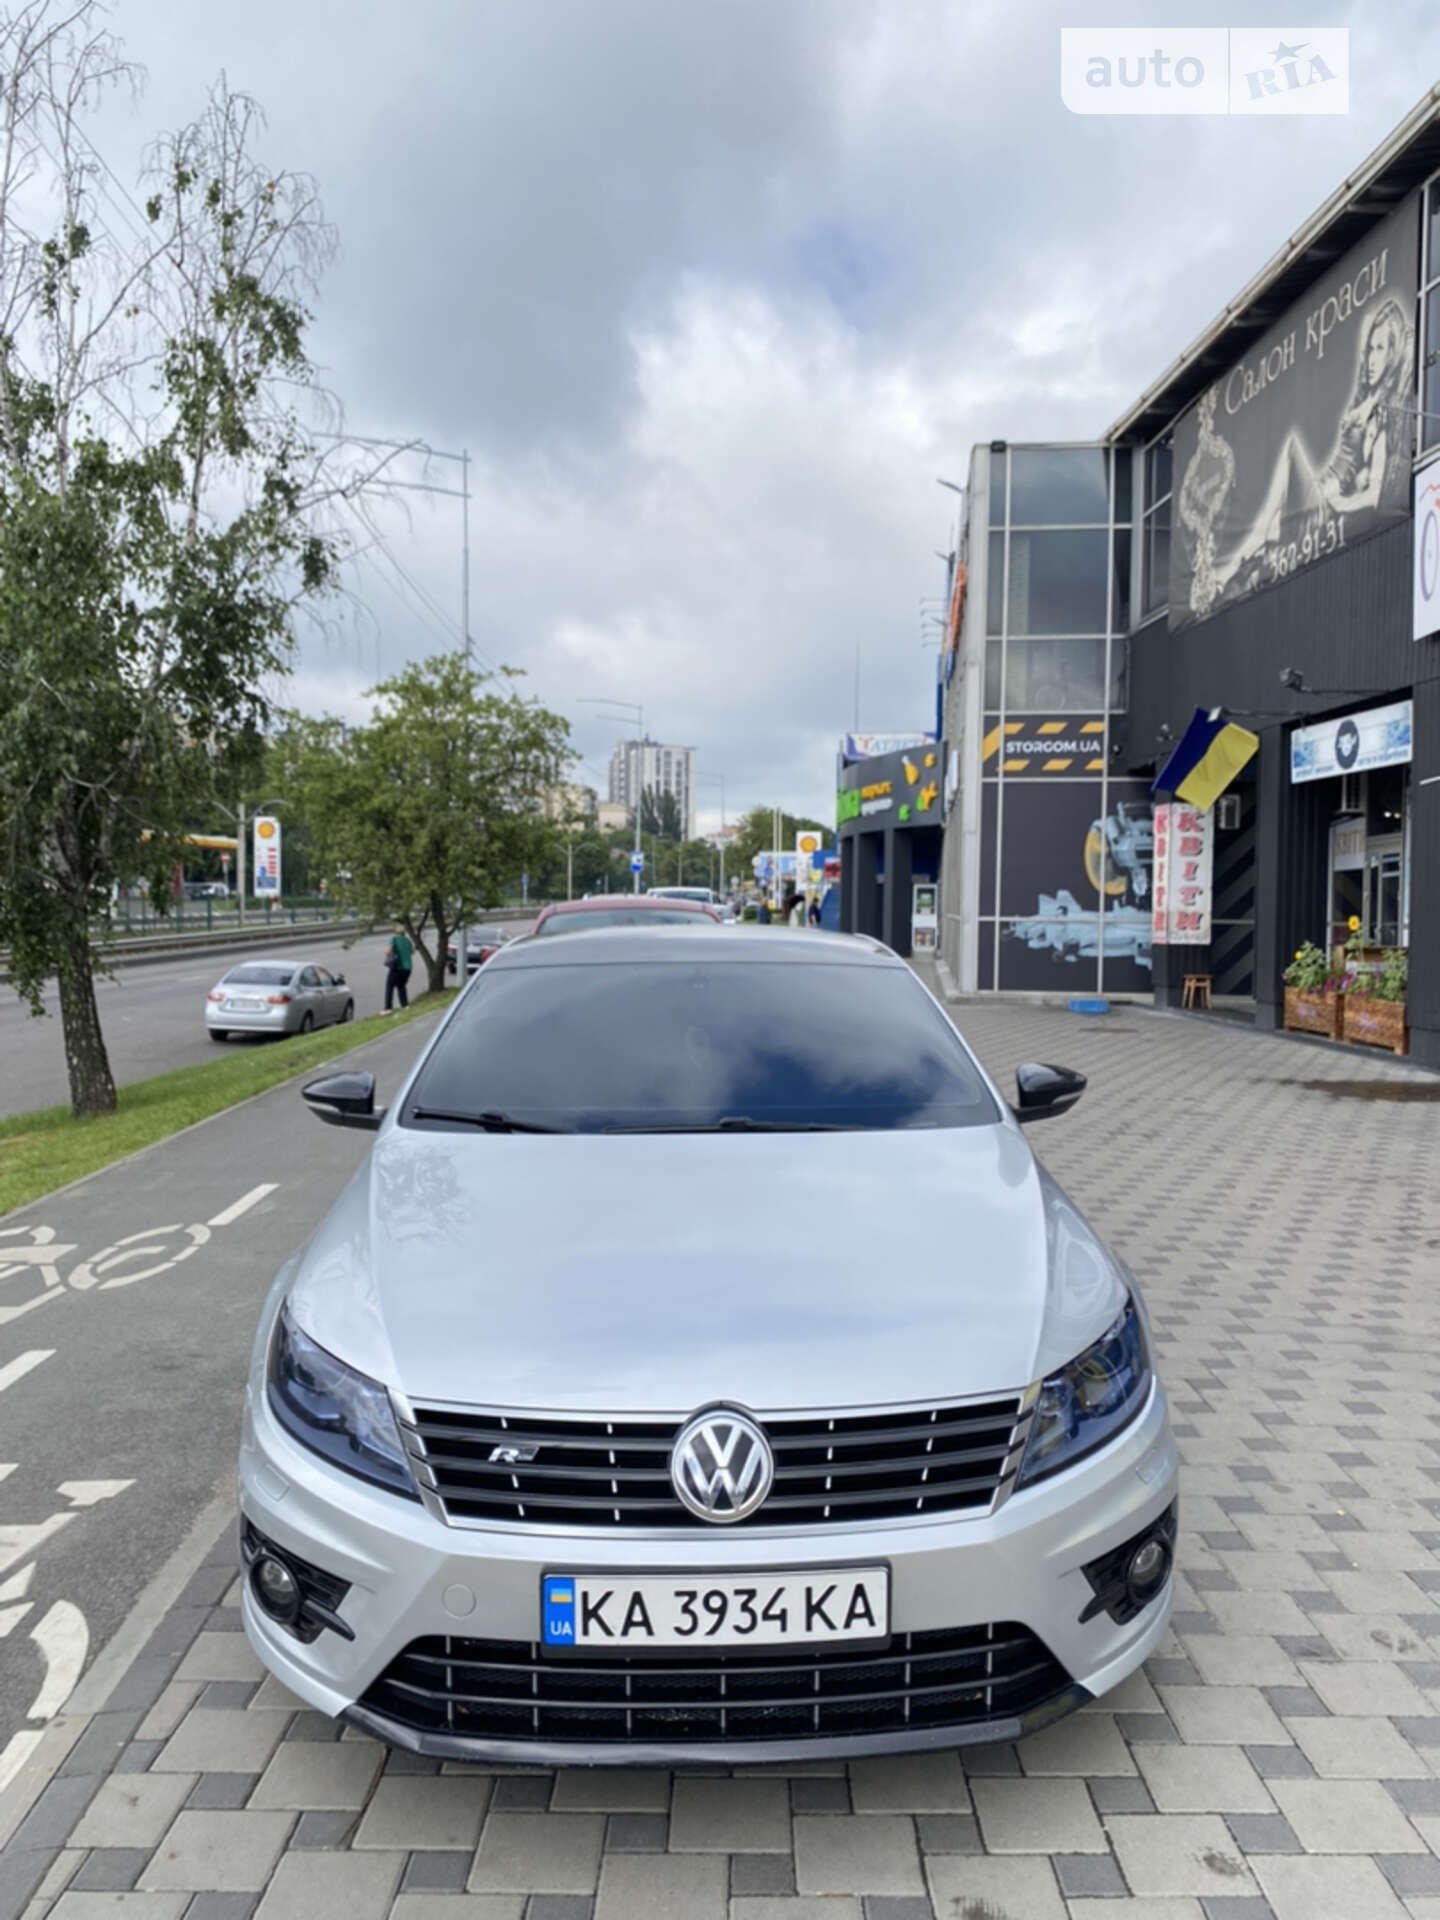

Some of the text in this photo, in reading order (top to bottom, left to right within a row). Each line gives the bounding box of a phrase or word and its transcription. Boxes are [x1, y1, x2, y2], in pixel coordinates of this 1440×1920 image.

[1225, 248, 1388, 415] Салон краси
[551, 1621, 573, 1636] UA
[581, 1583, 876, 1637] KA 3934 KA
